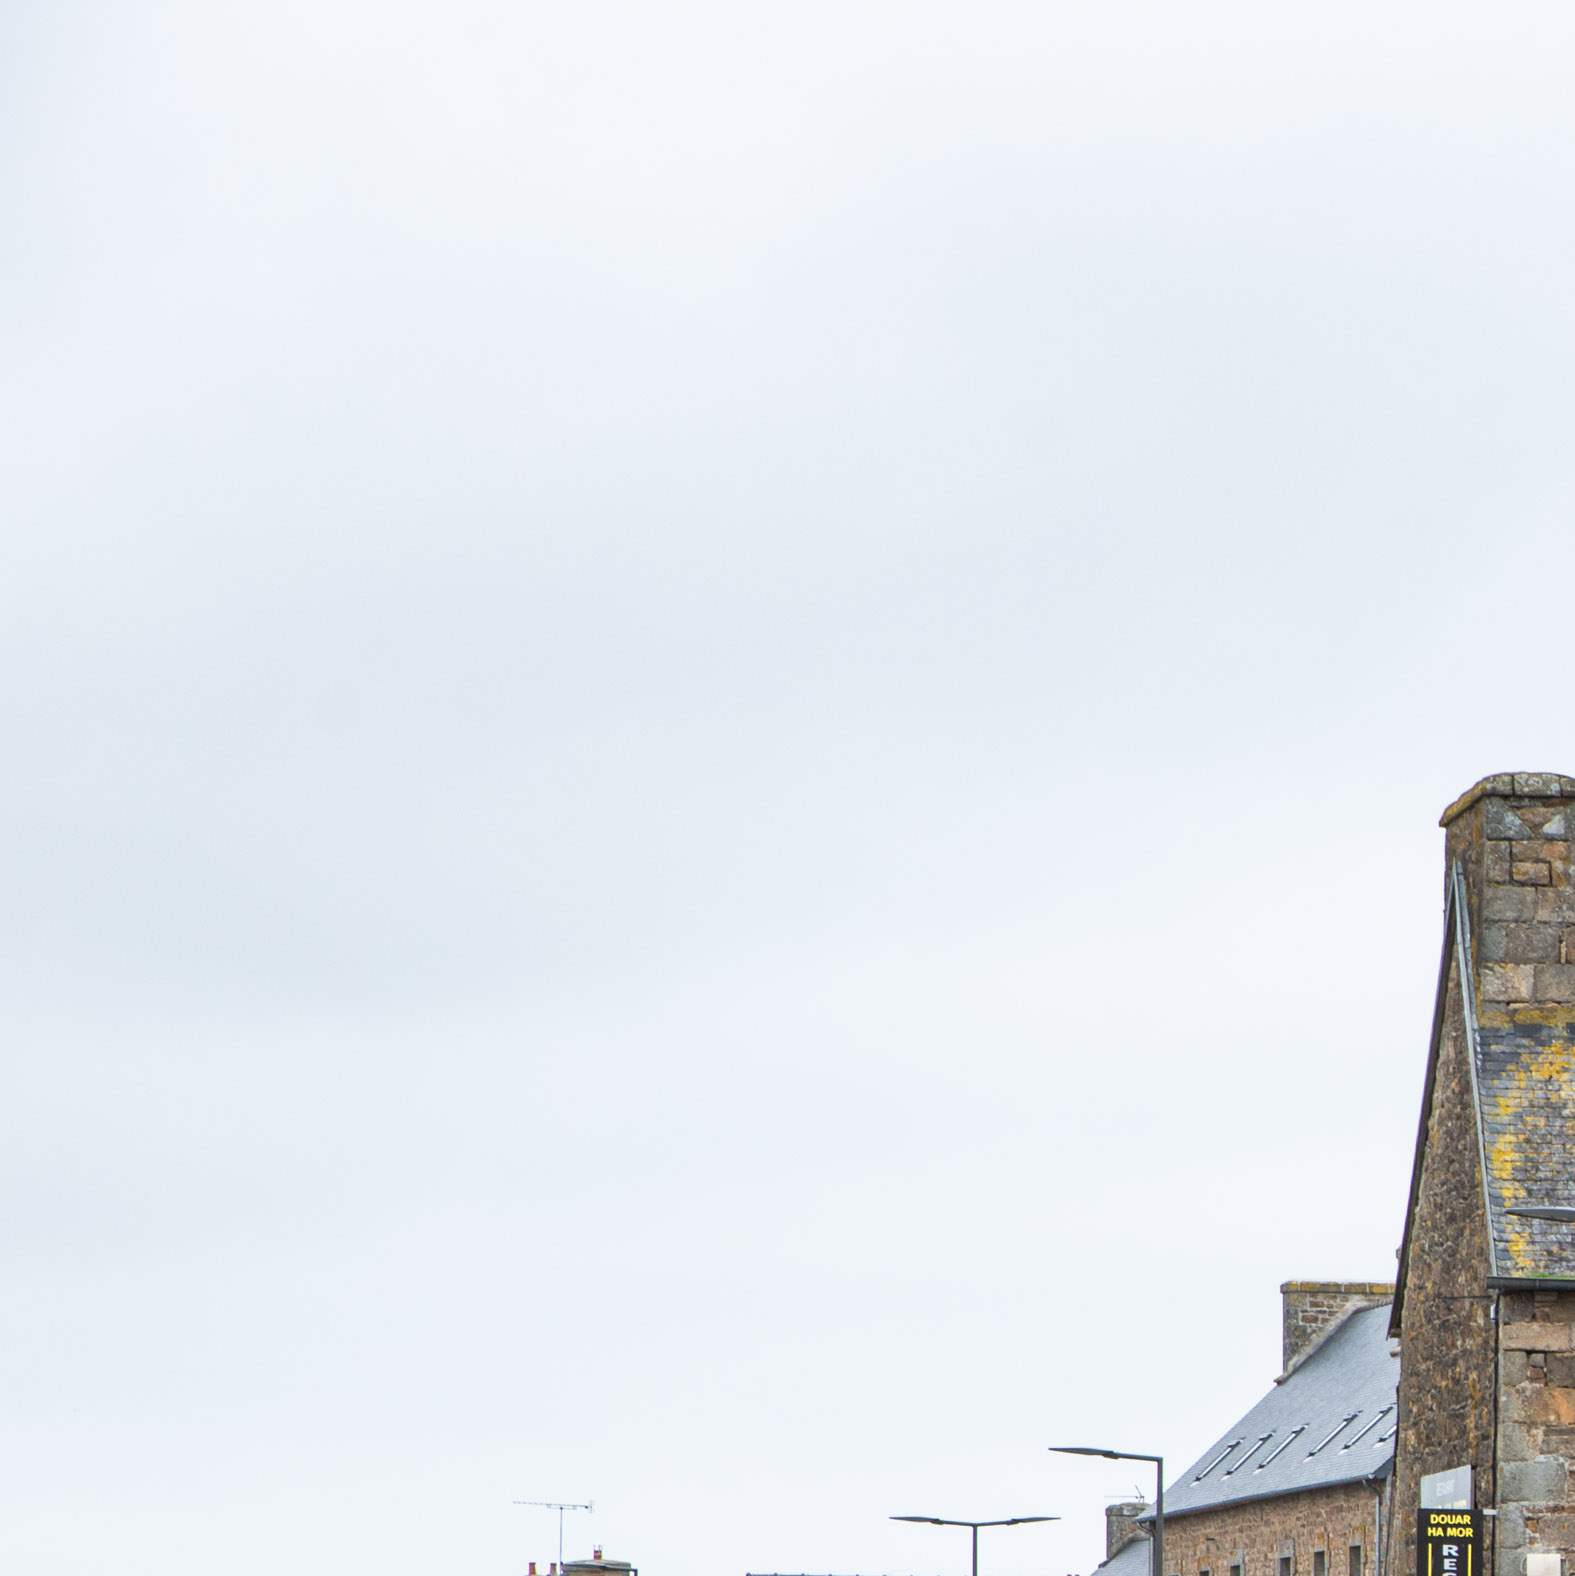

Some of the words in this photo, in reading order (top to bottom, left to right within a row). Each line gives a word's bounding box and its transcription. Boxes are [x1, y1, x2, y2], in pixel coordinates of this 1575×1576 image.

[1430, 1513, 1471, 1525] DOUAR
[1427, 1526, 1444, 1537] HA
[1446, 1527, 1474, 1538] MOR
